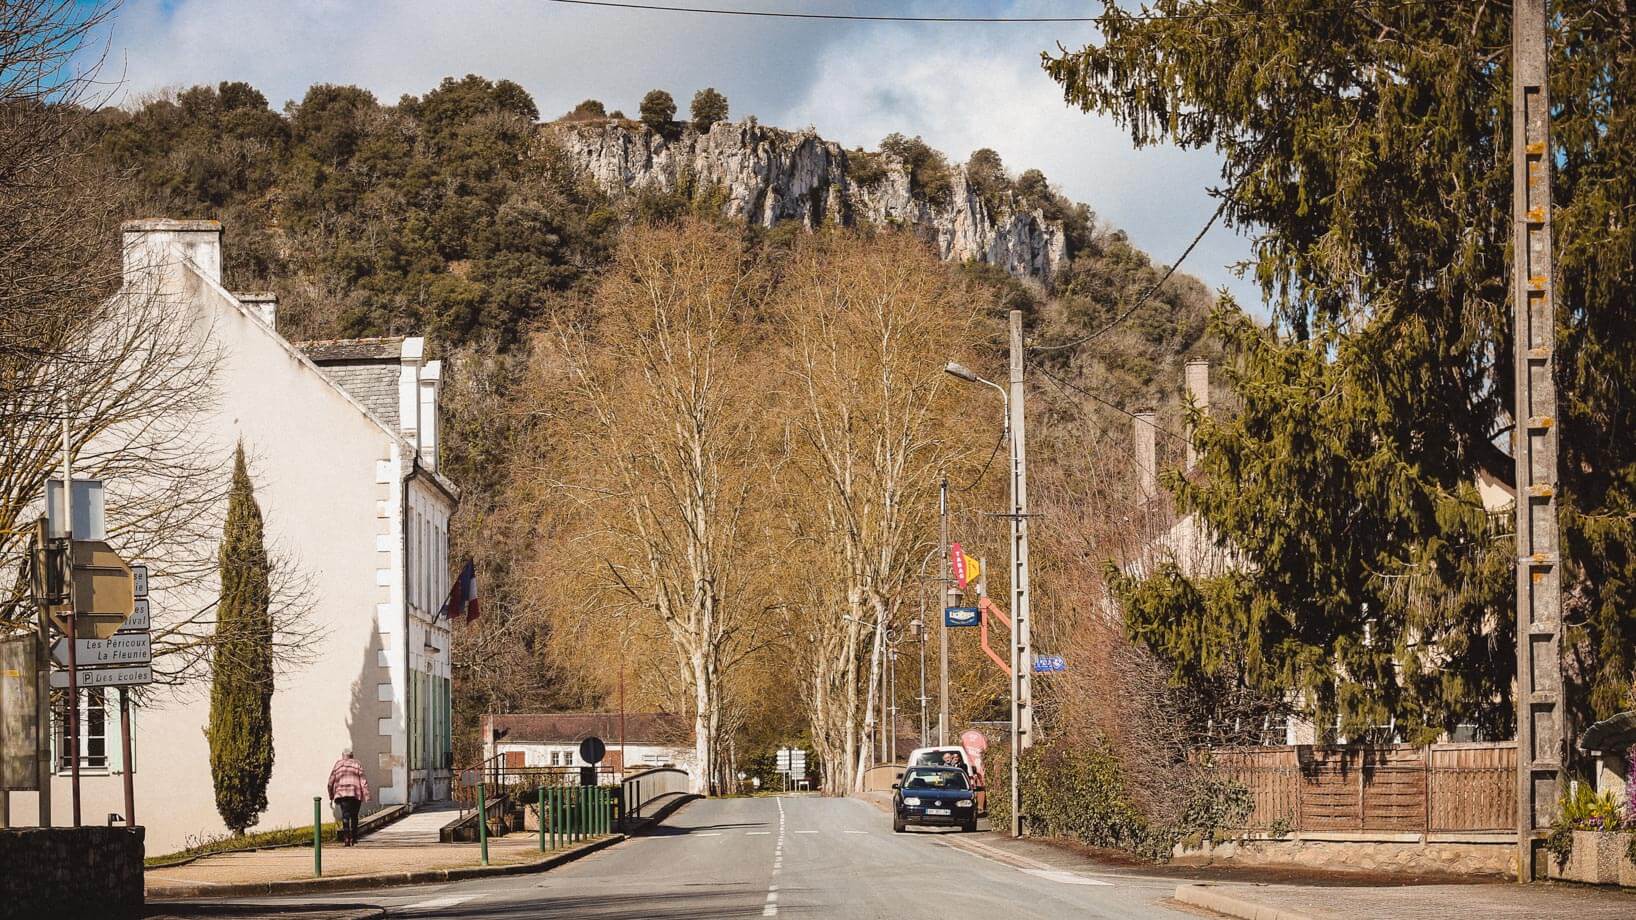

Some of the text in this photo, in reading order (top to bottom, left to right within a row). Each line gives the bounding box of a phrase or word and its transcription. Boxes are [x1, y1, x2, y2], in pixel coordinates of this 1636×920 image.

[86, 639, 146, 649] Les Péricoux
[97, 650, 147, 661] La Fleunie
